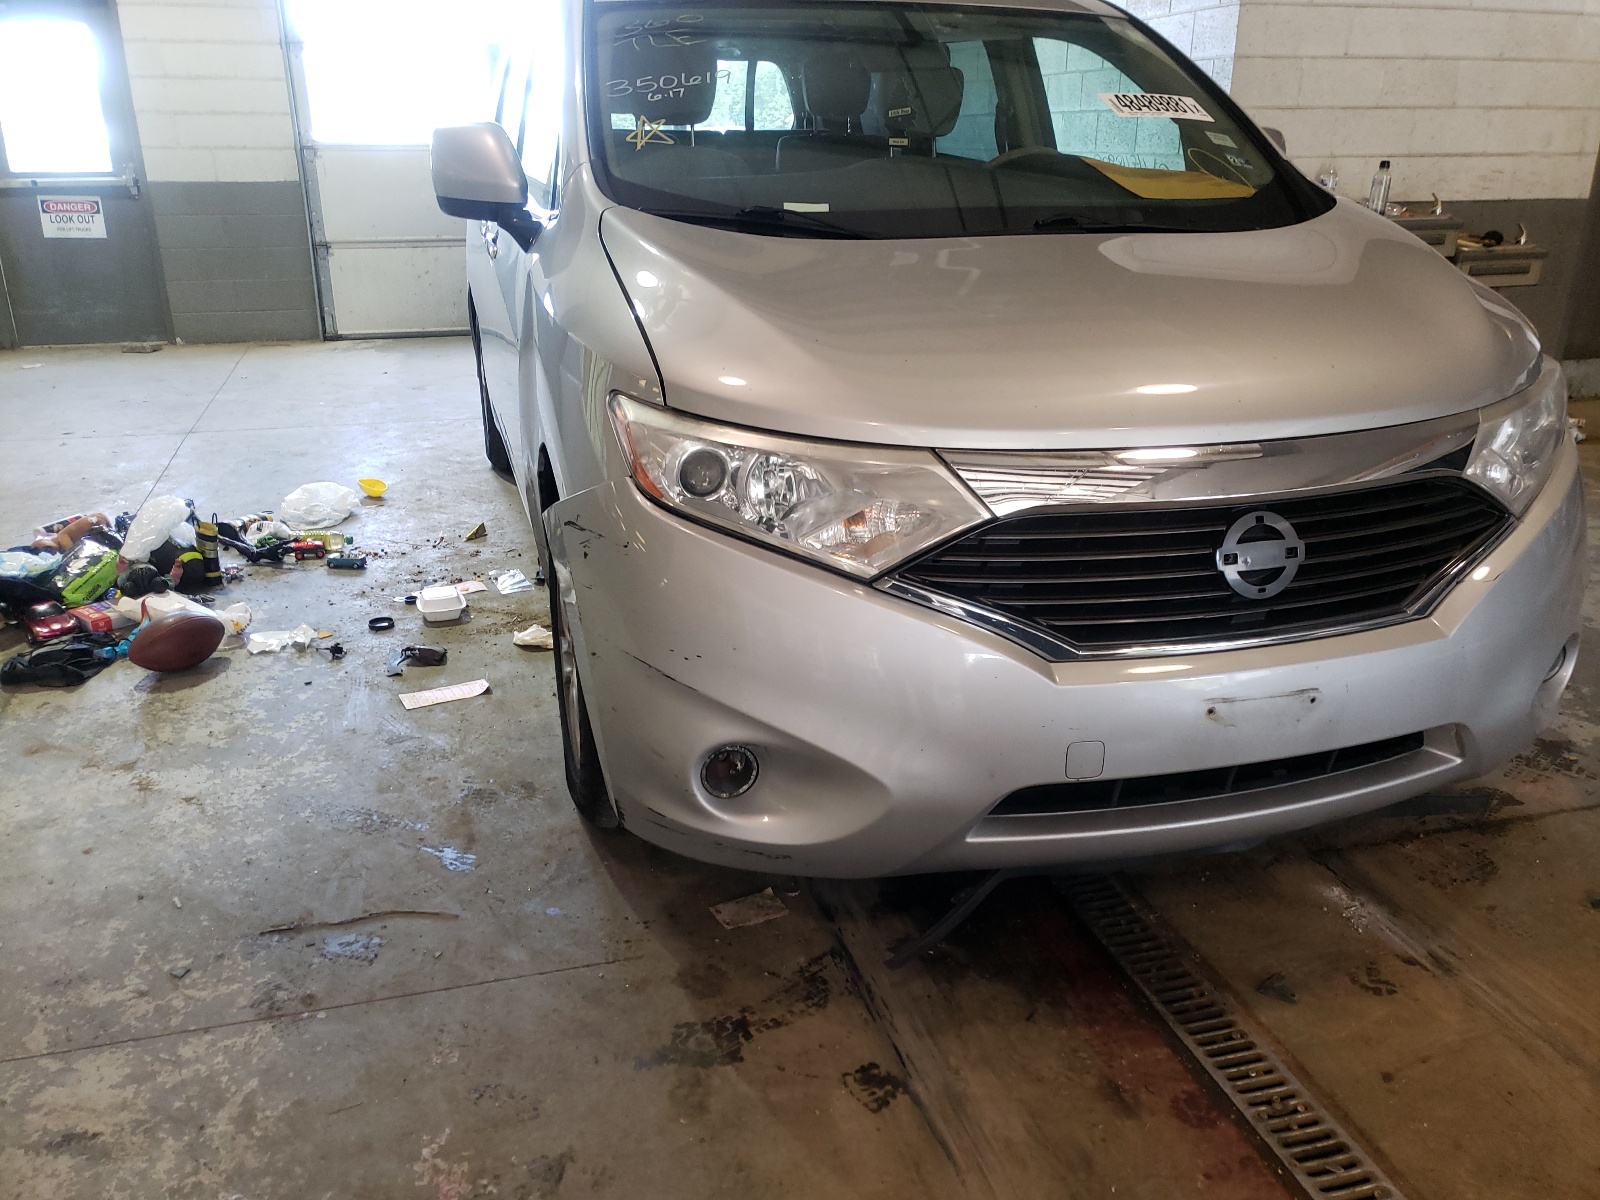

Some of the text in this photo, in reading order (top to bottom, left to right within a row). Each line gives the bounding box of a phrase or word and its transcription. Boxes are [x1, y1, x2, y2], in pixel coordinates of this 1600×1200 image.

[606, 69, 731, 97] 350619
[1113, 94, 1196, 114] 48489881
[49, 202, 91, 212] DANGER
[49, 214, 95, 224] LOOK OUT
